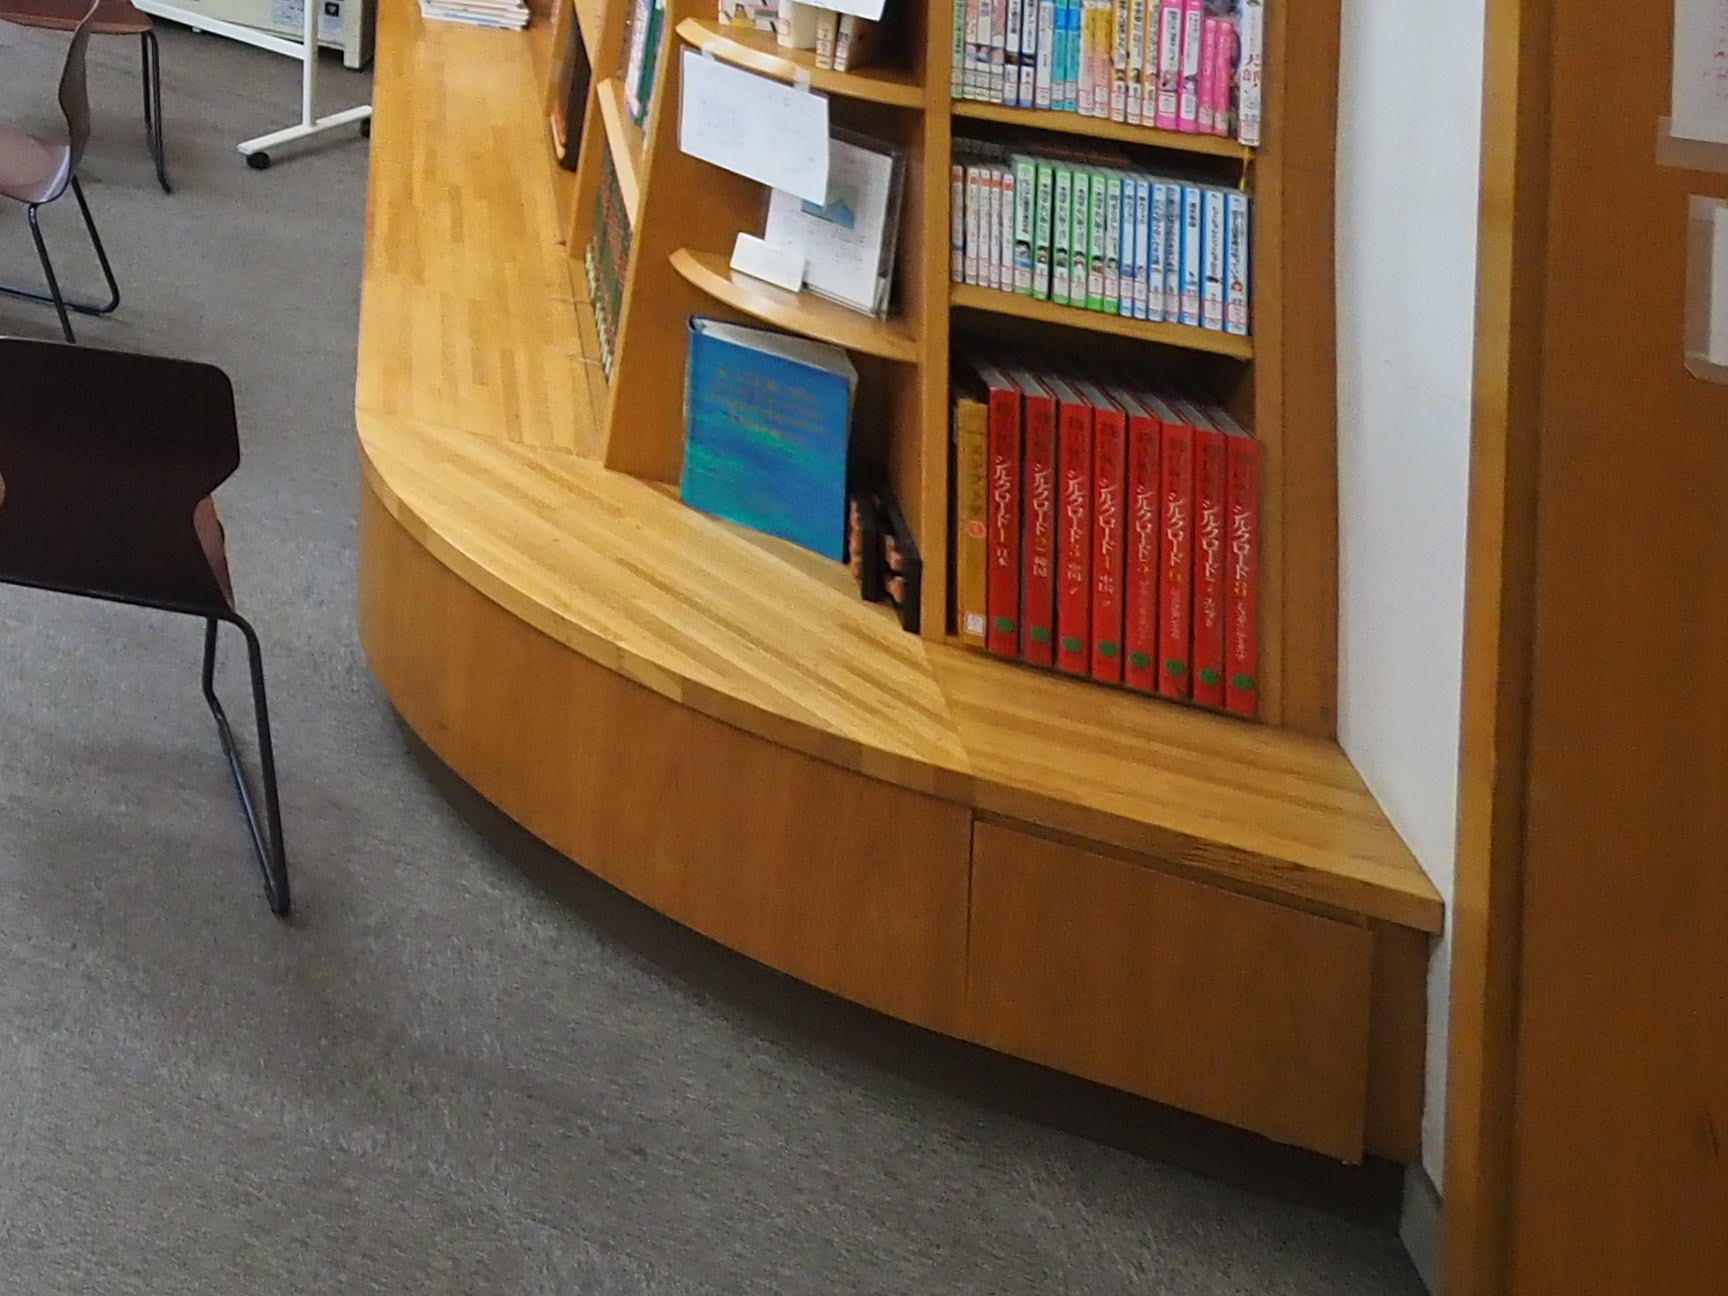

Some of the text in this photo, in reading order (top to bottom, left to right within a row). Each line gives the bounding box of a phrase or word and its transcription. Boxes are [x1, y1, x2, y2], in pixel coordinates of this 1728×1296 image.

[993, 455, 1012, 528] シルクロード
[1032, 463, 1051, 536] シルクロード
[1065, 470, 1085, 543] シルクロード
[1099, 478, 1119, 555] シルクロード
[1135, 484, 1155, 562] シルクロード
[1166, 492, 1186, 567] シルクロード
[1201, 499, 1219, 577] シルクロード
[1232, 504, 1252, 580] シルクロード
